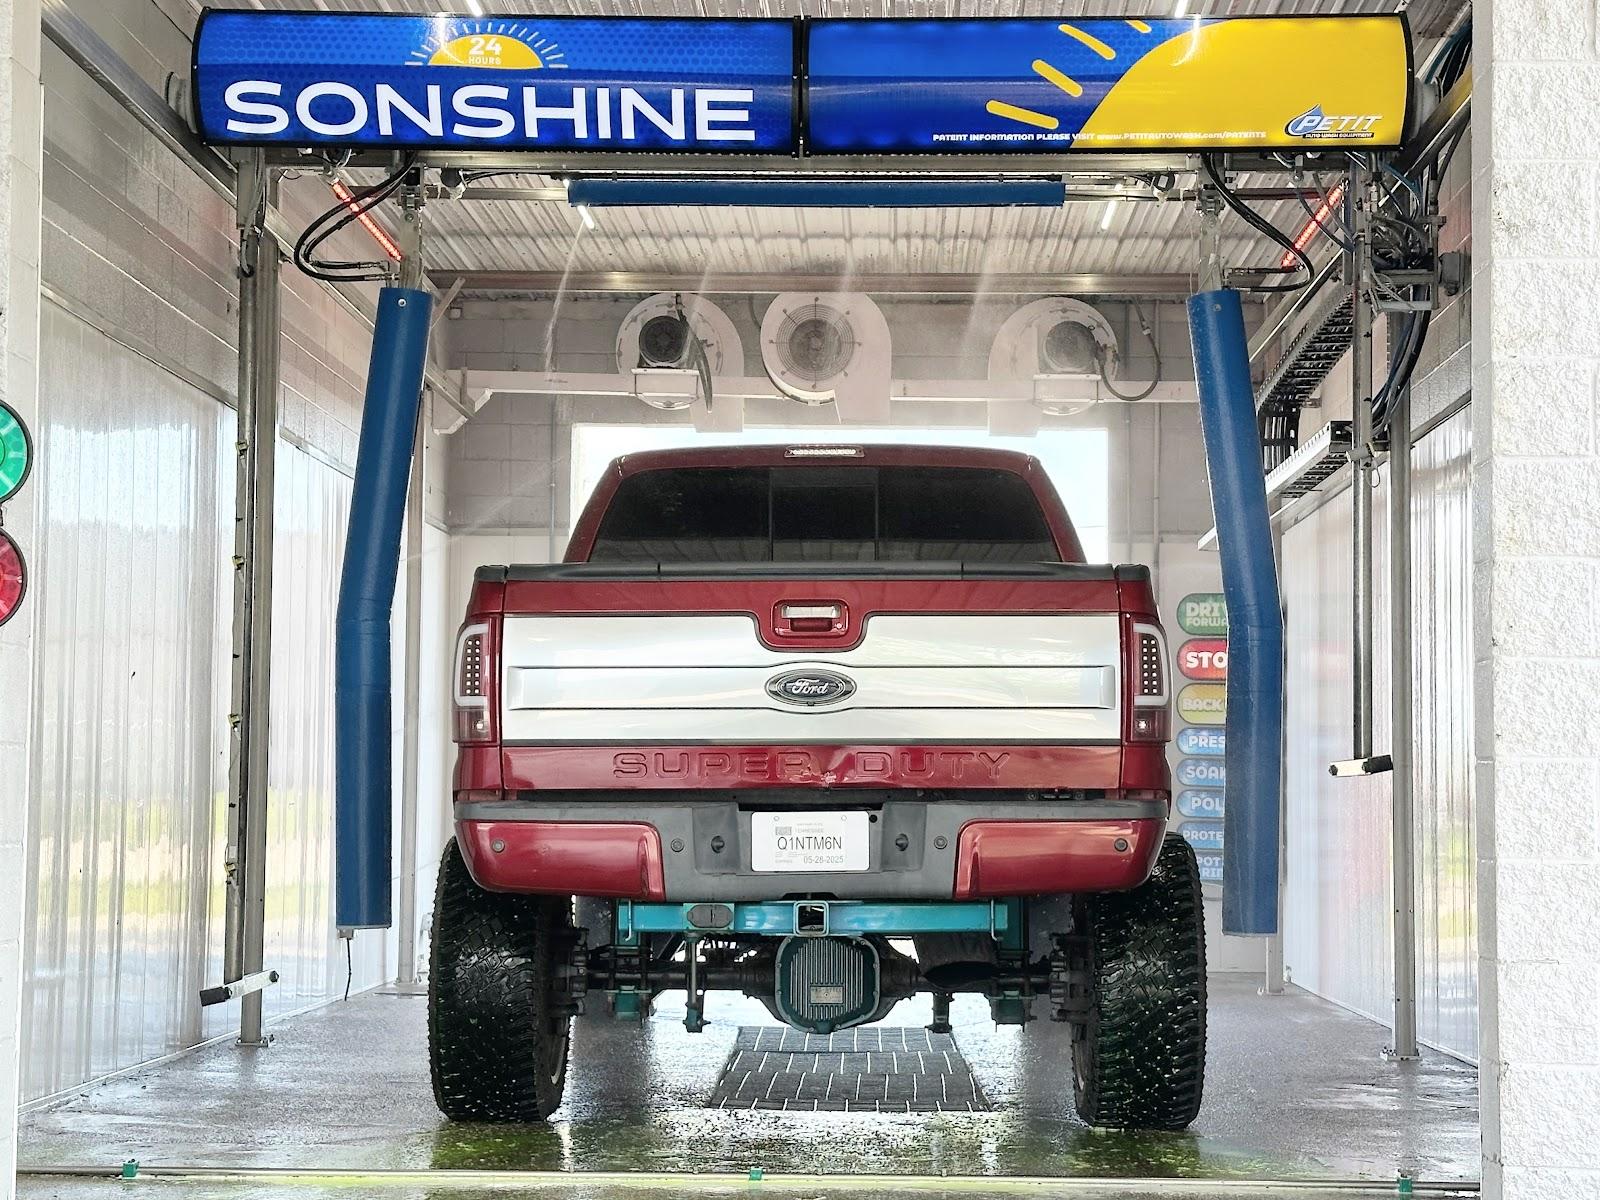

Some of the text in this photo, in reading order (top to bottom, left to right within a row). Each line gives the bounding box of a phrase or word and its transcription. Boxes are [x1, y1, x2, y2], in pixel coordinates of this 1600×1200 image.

[468, 37, 503, 56] 24
[468, 56, 502, 65] HOURS
[223, 79, 756, 142] SONSHINE
[1294, 115, 1384, 132] PETIT
[1036, 133, 1071, 141] PLEASE
[1072, 132, 1097, 140] VISIT
[1185, 651, 1228, 669] STO
[791, 677, 829, 696] Ford
[1182, 698, 1224, 712] BACK
[612, 751, 1011, 781] SUPER DUTY
[803, 855, 844, 865] 05-28-2025
